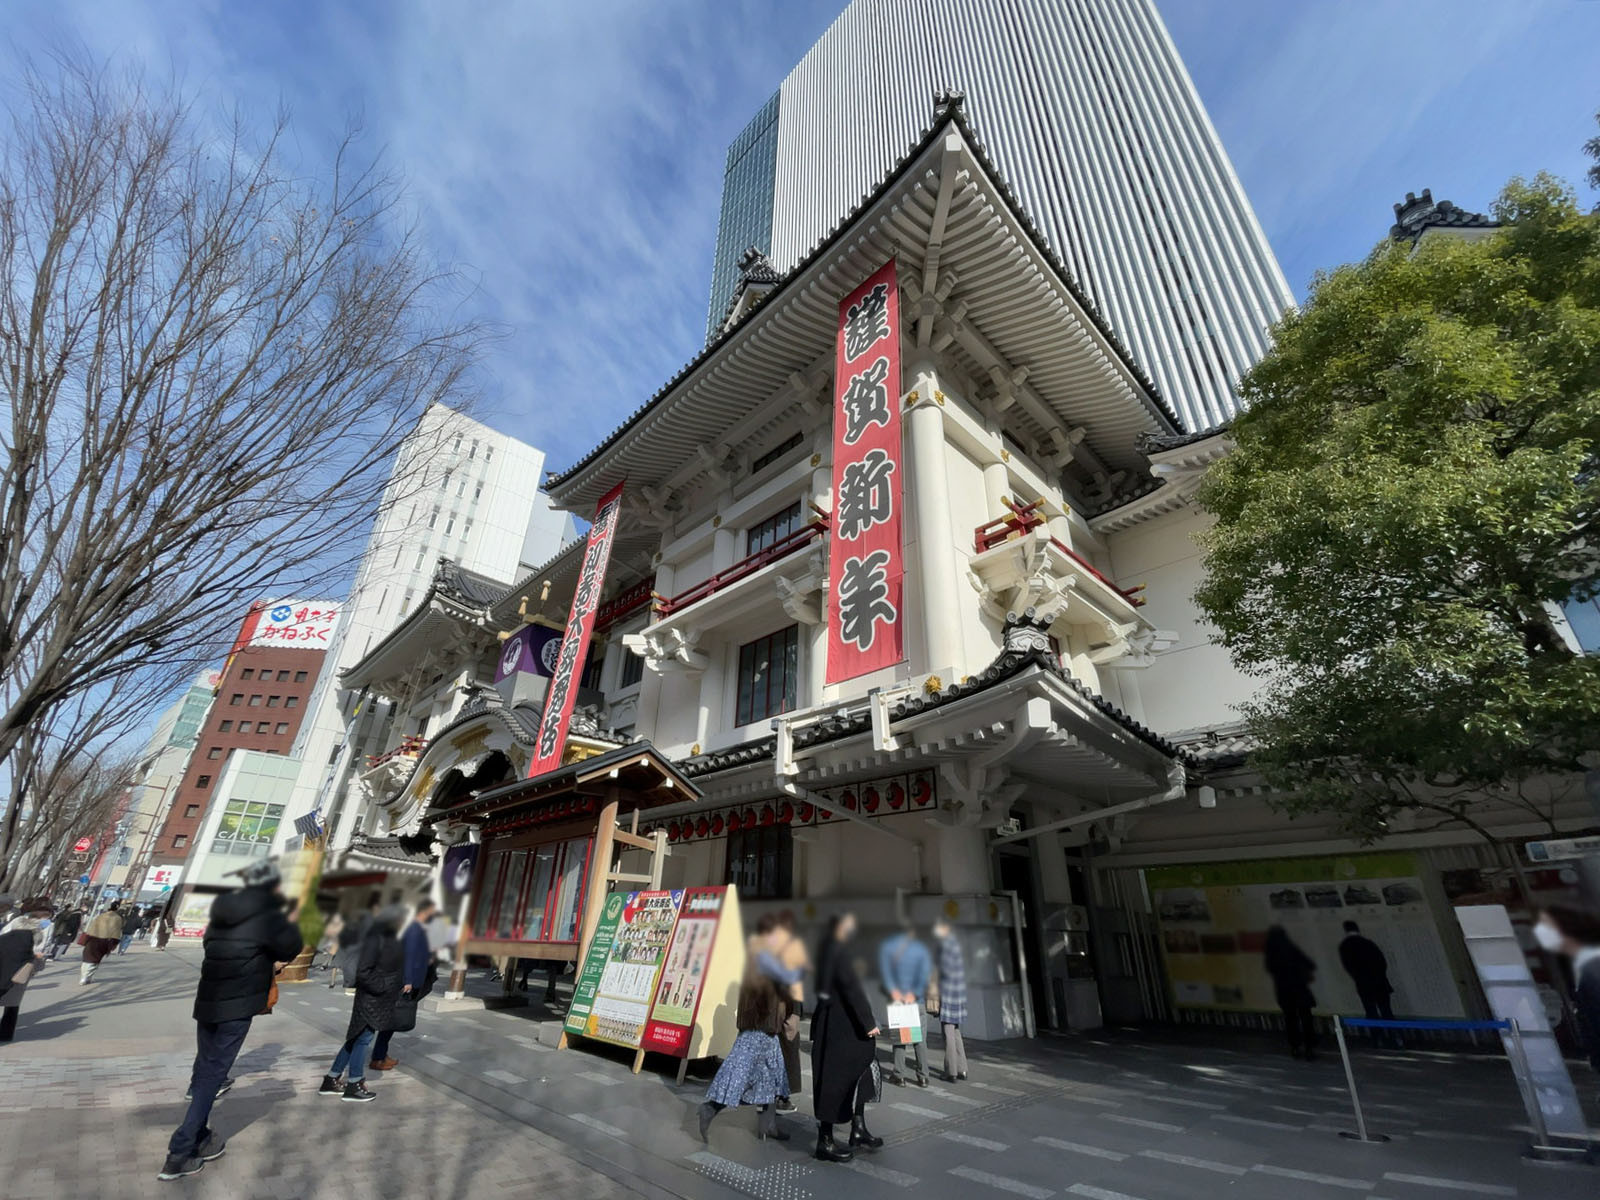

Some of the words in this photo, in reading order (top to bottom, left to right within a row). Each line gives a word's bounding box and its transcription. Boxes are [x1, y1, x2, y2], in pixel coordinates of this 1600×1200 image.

[837, 282, 898, 653] 謹賀新年
[264, 624, 330, 641] かねふく
